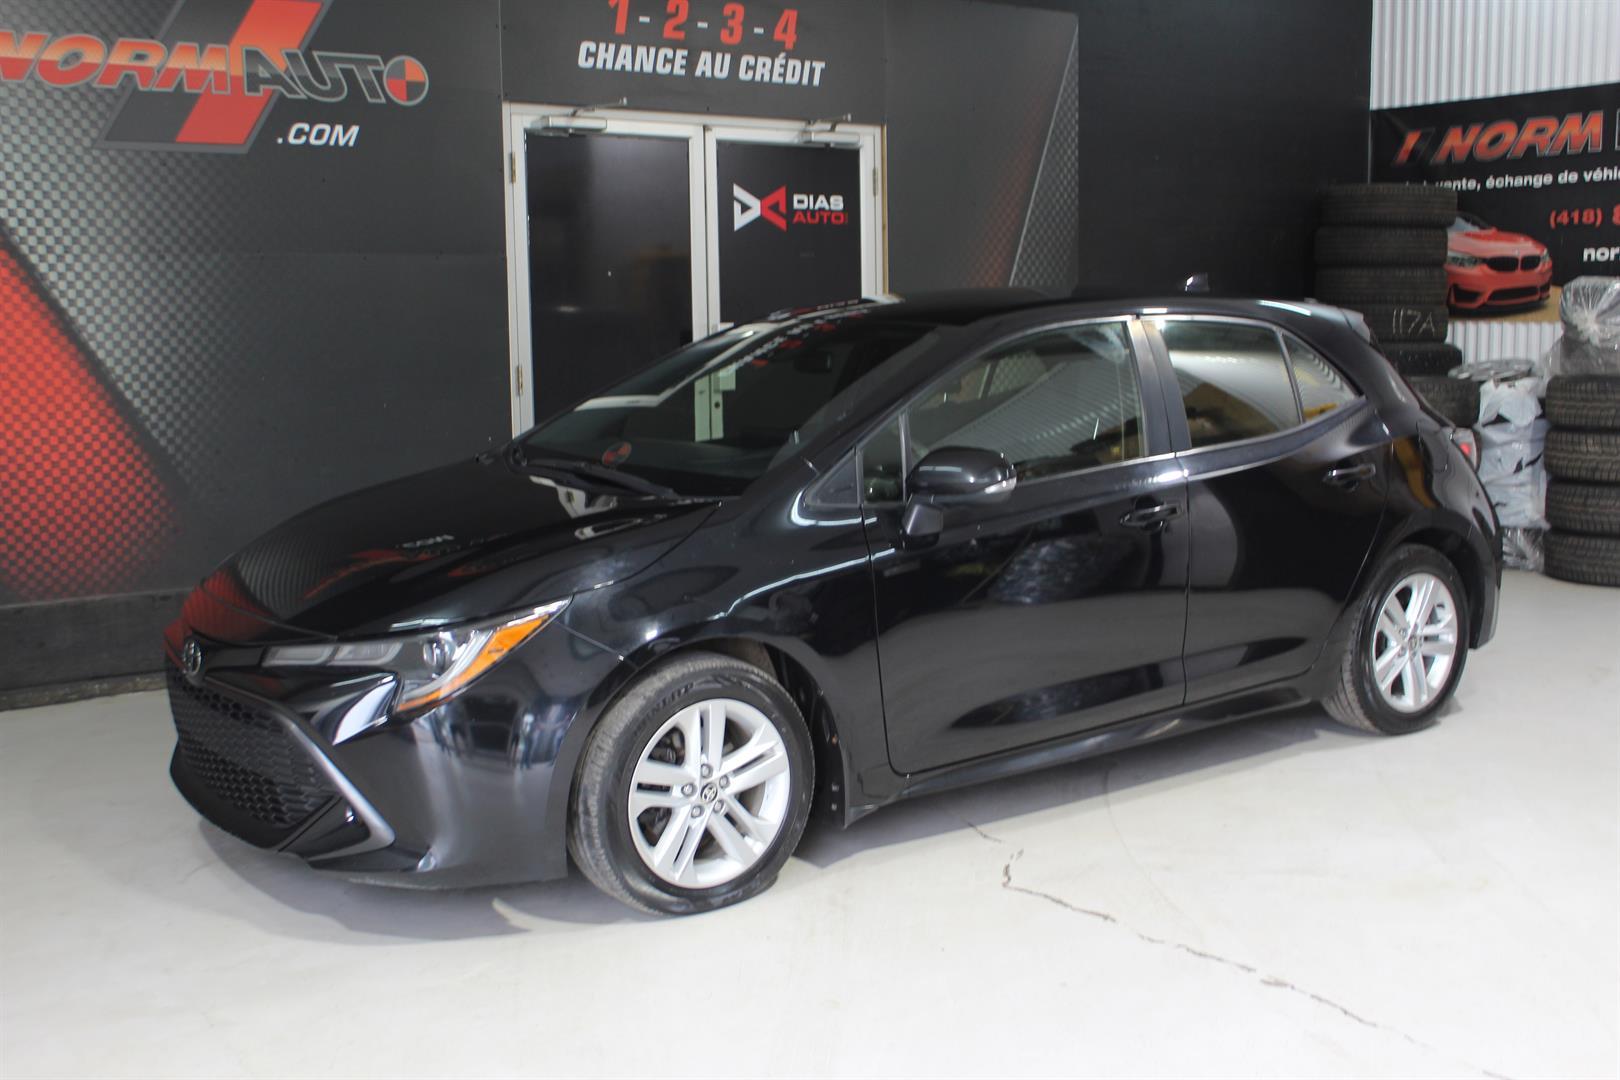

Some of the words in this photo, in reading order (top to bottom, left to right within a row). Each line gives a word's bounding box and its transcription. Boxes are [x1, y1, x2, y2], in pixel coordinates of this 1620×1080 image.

[577, 40, 688, 76] CHANCE
[694, 51, 731, 79] AU
[738, 53, 826, 87] CRÉDIT
[277, 122, 360, 147] .COM
[1429, 110, 1604, 166] NORM
[1485, 173, 1553, 189] échange
[1558, 169, 1579, 184] de
[793, 193, 844, 211] DIAS
[792, 210, 845, 225] AUTO
[1550, 207, 1603, 230] (418)
